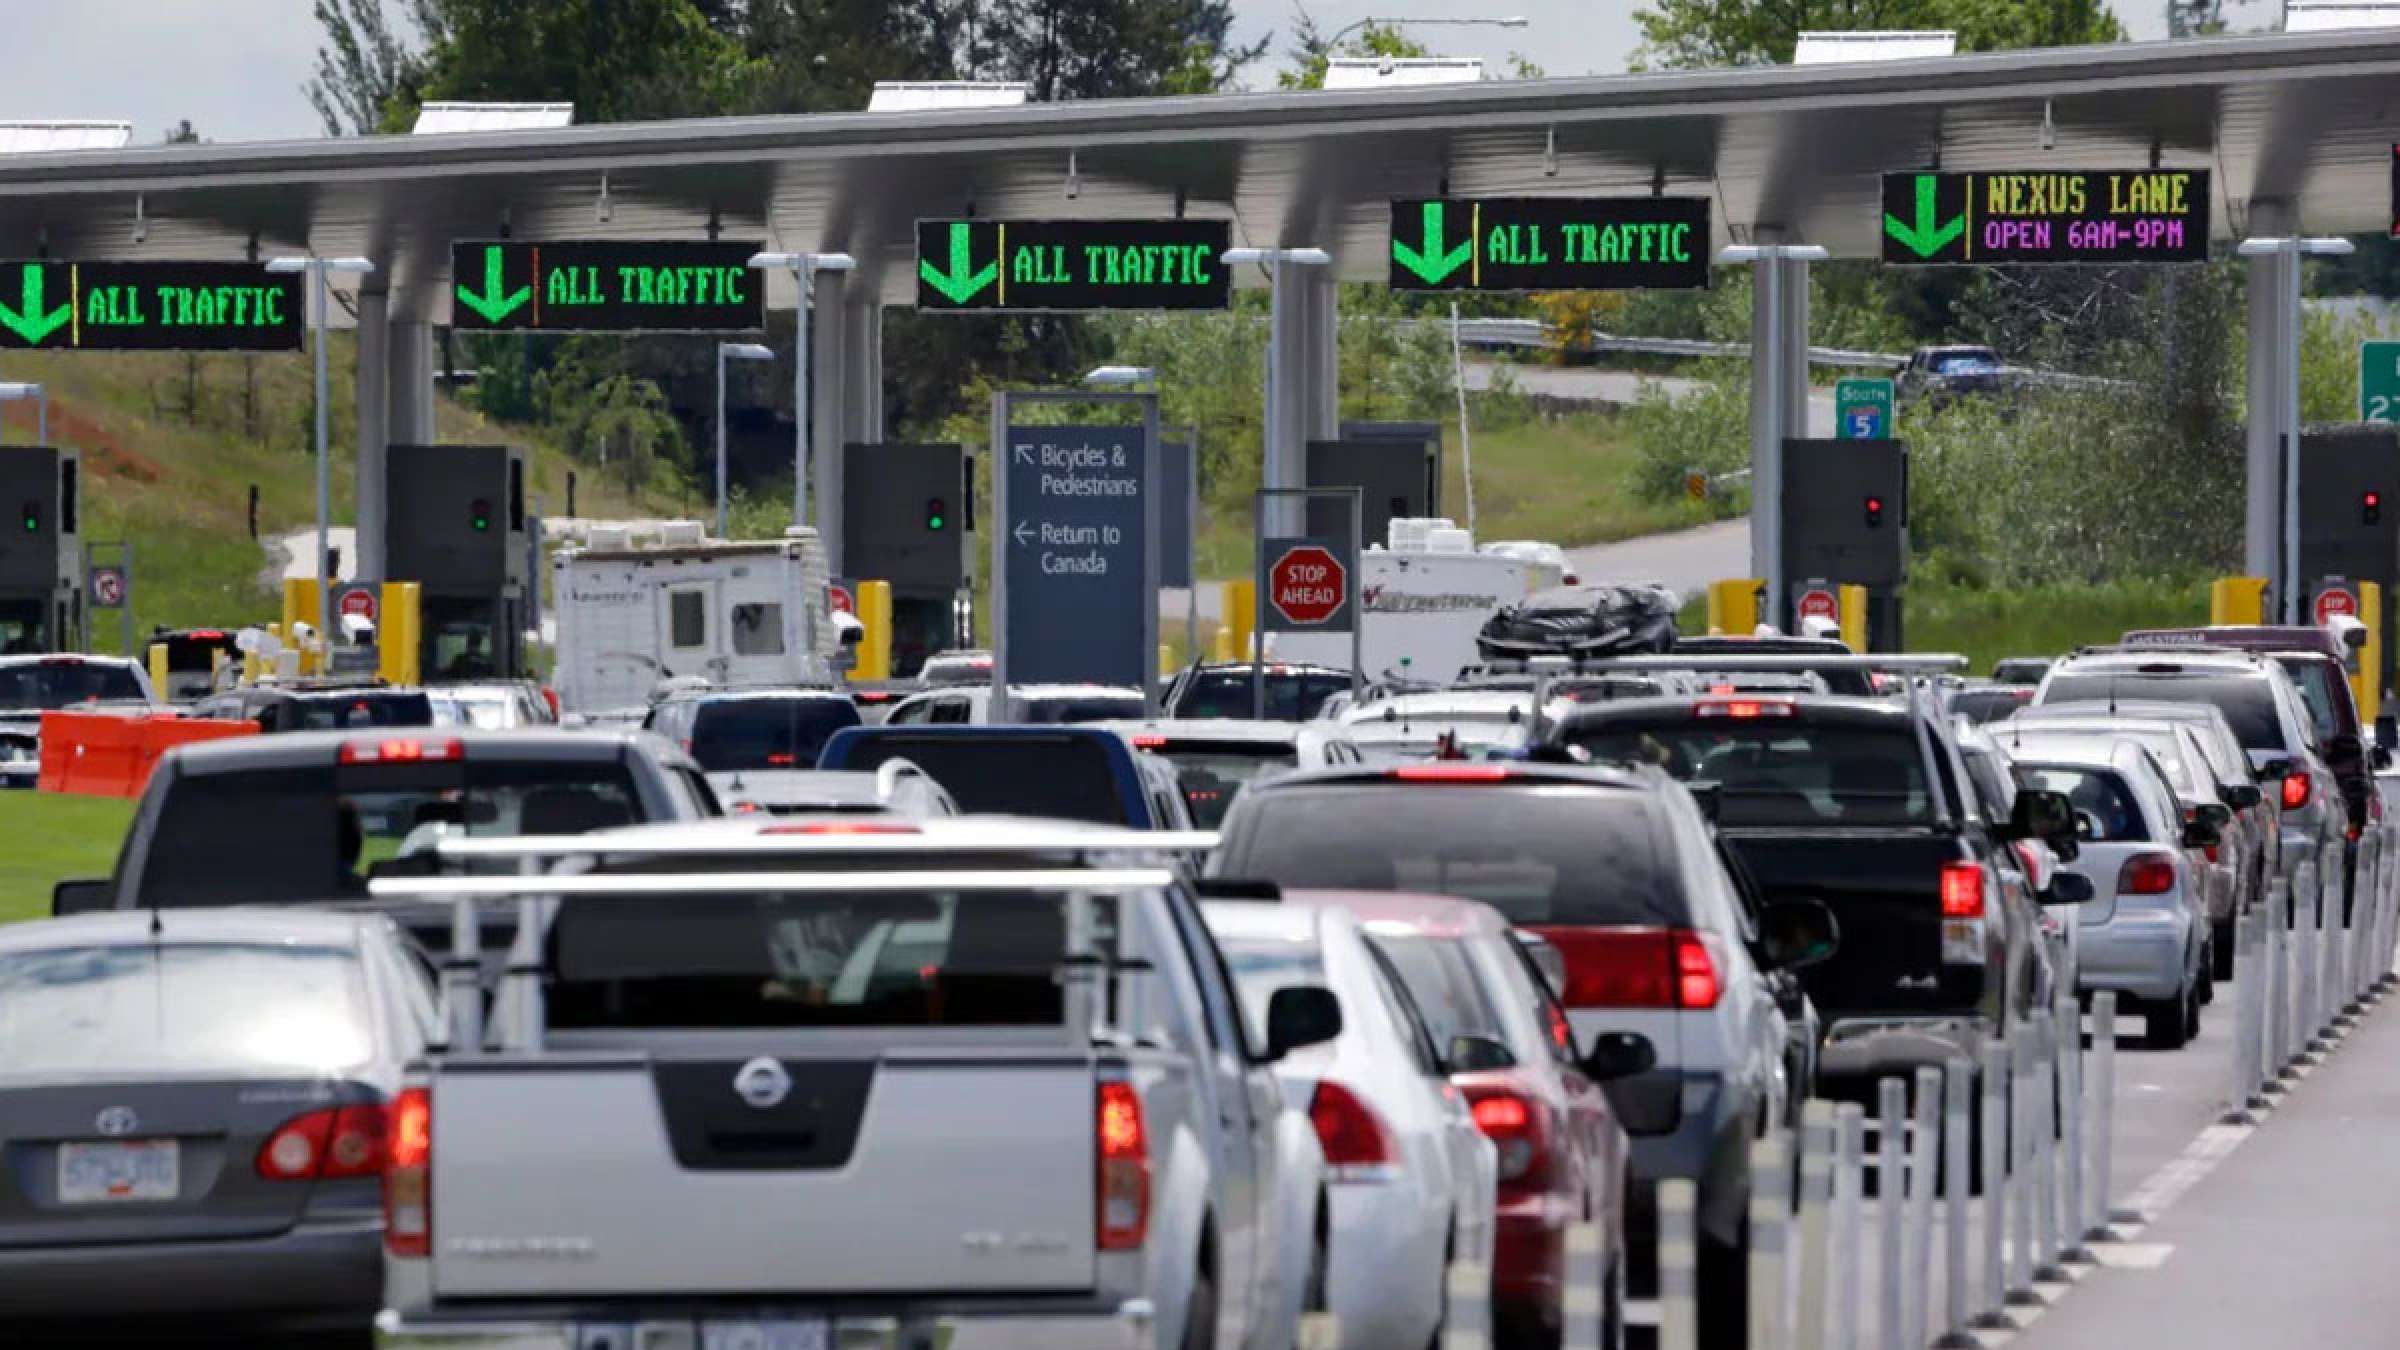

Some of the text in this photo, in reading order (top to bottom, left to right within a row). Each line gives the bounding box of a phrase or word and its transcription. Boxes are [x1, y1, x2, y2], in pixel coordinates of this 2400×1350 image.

[1987, 174, 2190, 215] NEXUS LANE
[1487, 223, 1690, 265] ALL TRAFFIC
[1984, 219, 2185, 249] OPEN 6AM-9PM
[1013, 244, 1212, 285] ALL TRAFFIC
[547, 267, 745, 305] ALL TRAFFIC
[87, 285, 284, 326] ALL TRAFFIC
[1856, 415, 1871, 437] 5
[1041, 442, 1126, 472] Bicycles &
[1041, 474, 1137, 496] Pedestrians
[1041, 522, 1121, 545] Return to
[1041, 551, 1107, 574] Canada
[1288, 564, 1327, 582] STOP
[1281, 587, 1335, 604] AHEAD
